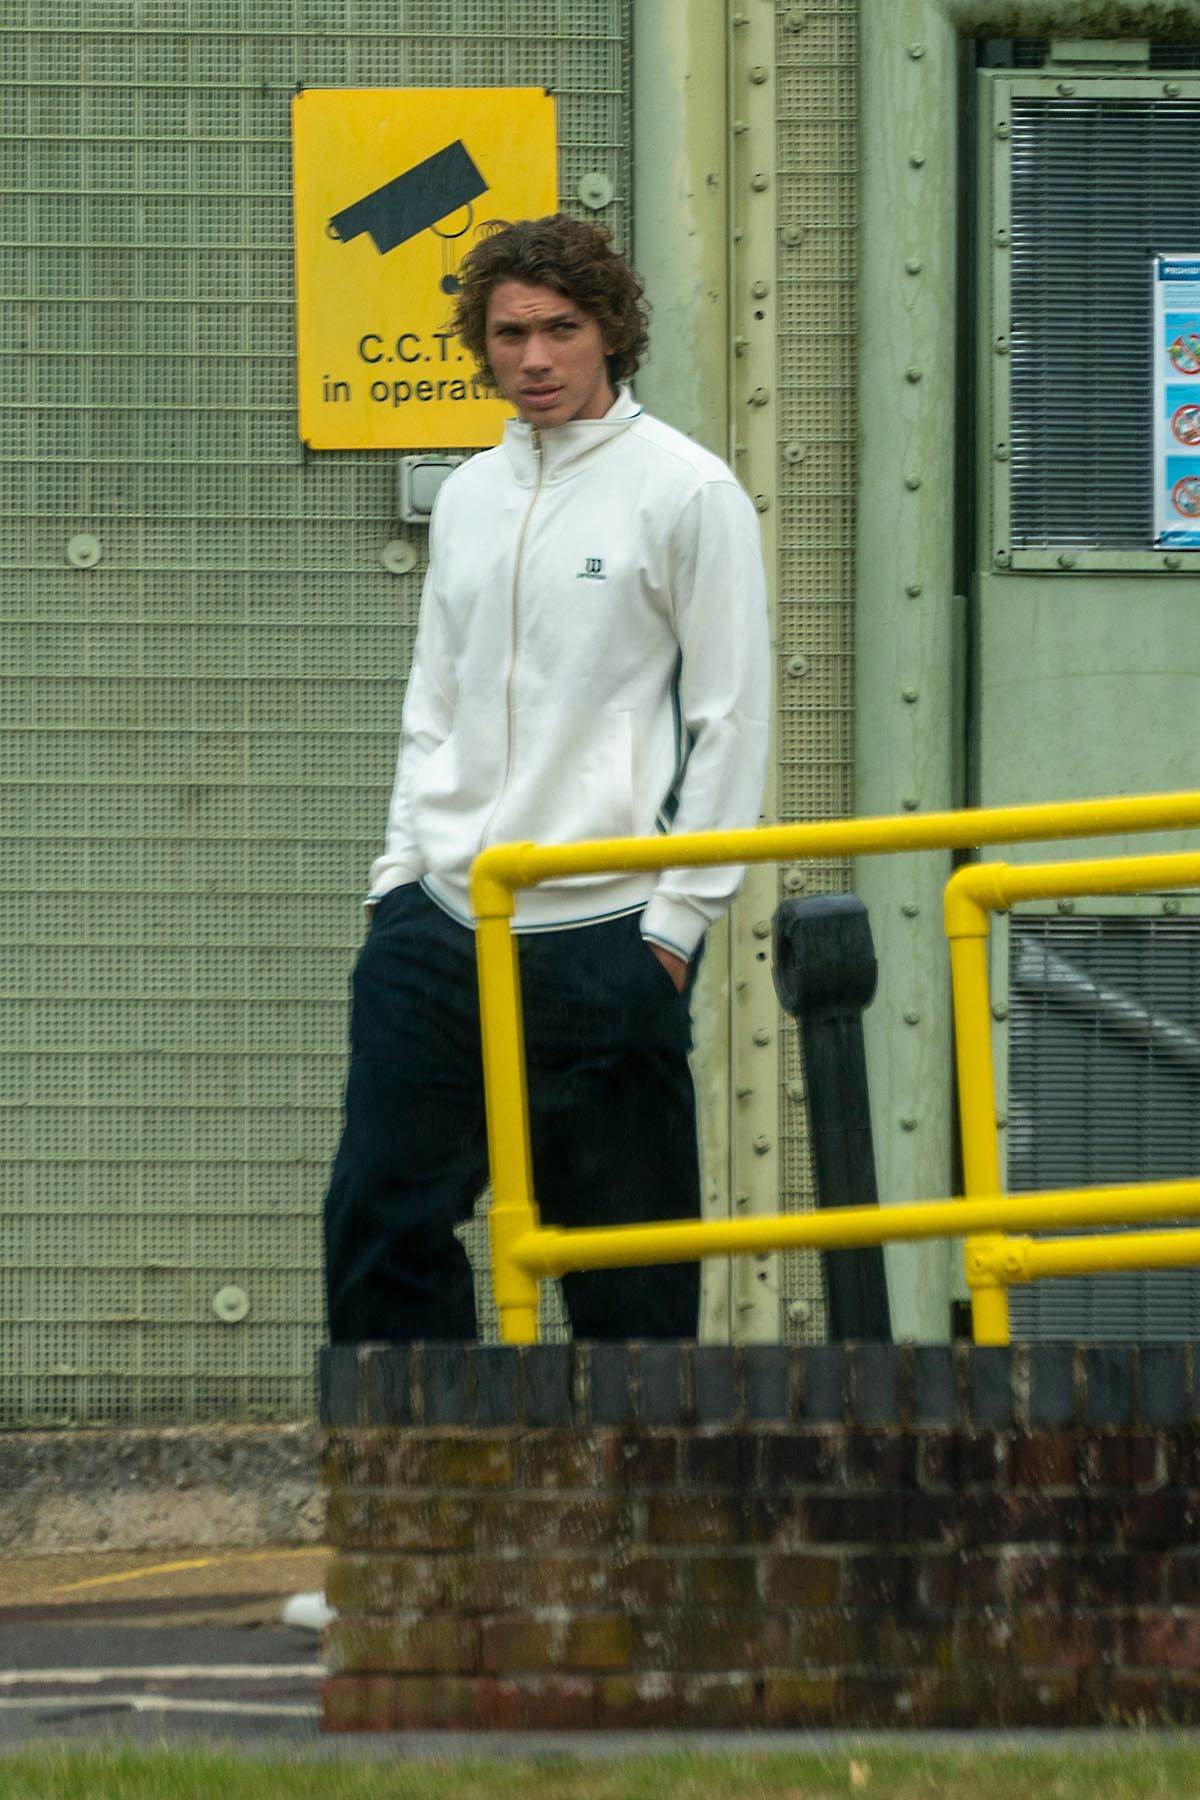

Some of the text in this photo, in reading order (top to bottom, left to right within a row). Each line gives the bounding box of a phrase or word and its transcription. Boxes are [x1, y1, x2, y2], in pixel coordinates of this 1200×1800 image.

[359, 334, 463, 363] C.C.T.
[322, 375, 489, 408] in operat
